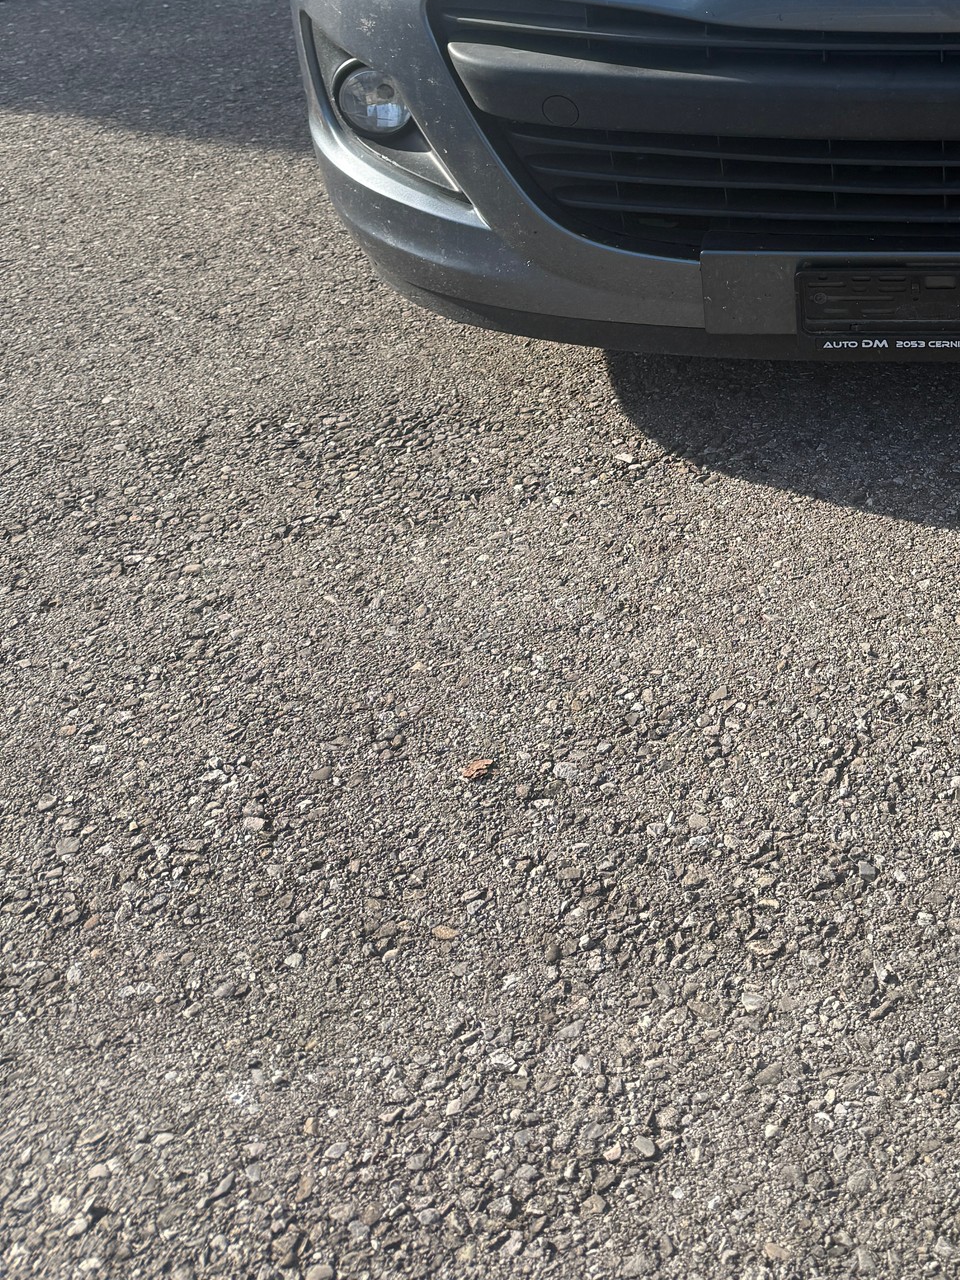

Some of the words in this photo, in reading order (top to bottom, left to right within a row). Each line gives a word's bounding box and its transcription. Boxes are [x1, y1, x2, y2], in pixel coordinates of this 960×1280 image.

[823, 341, 859, 349] AUTO
[861, 339, 889, 348] DM
[896, 340, 926, 348] 2053
